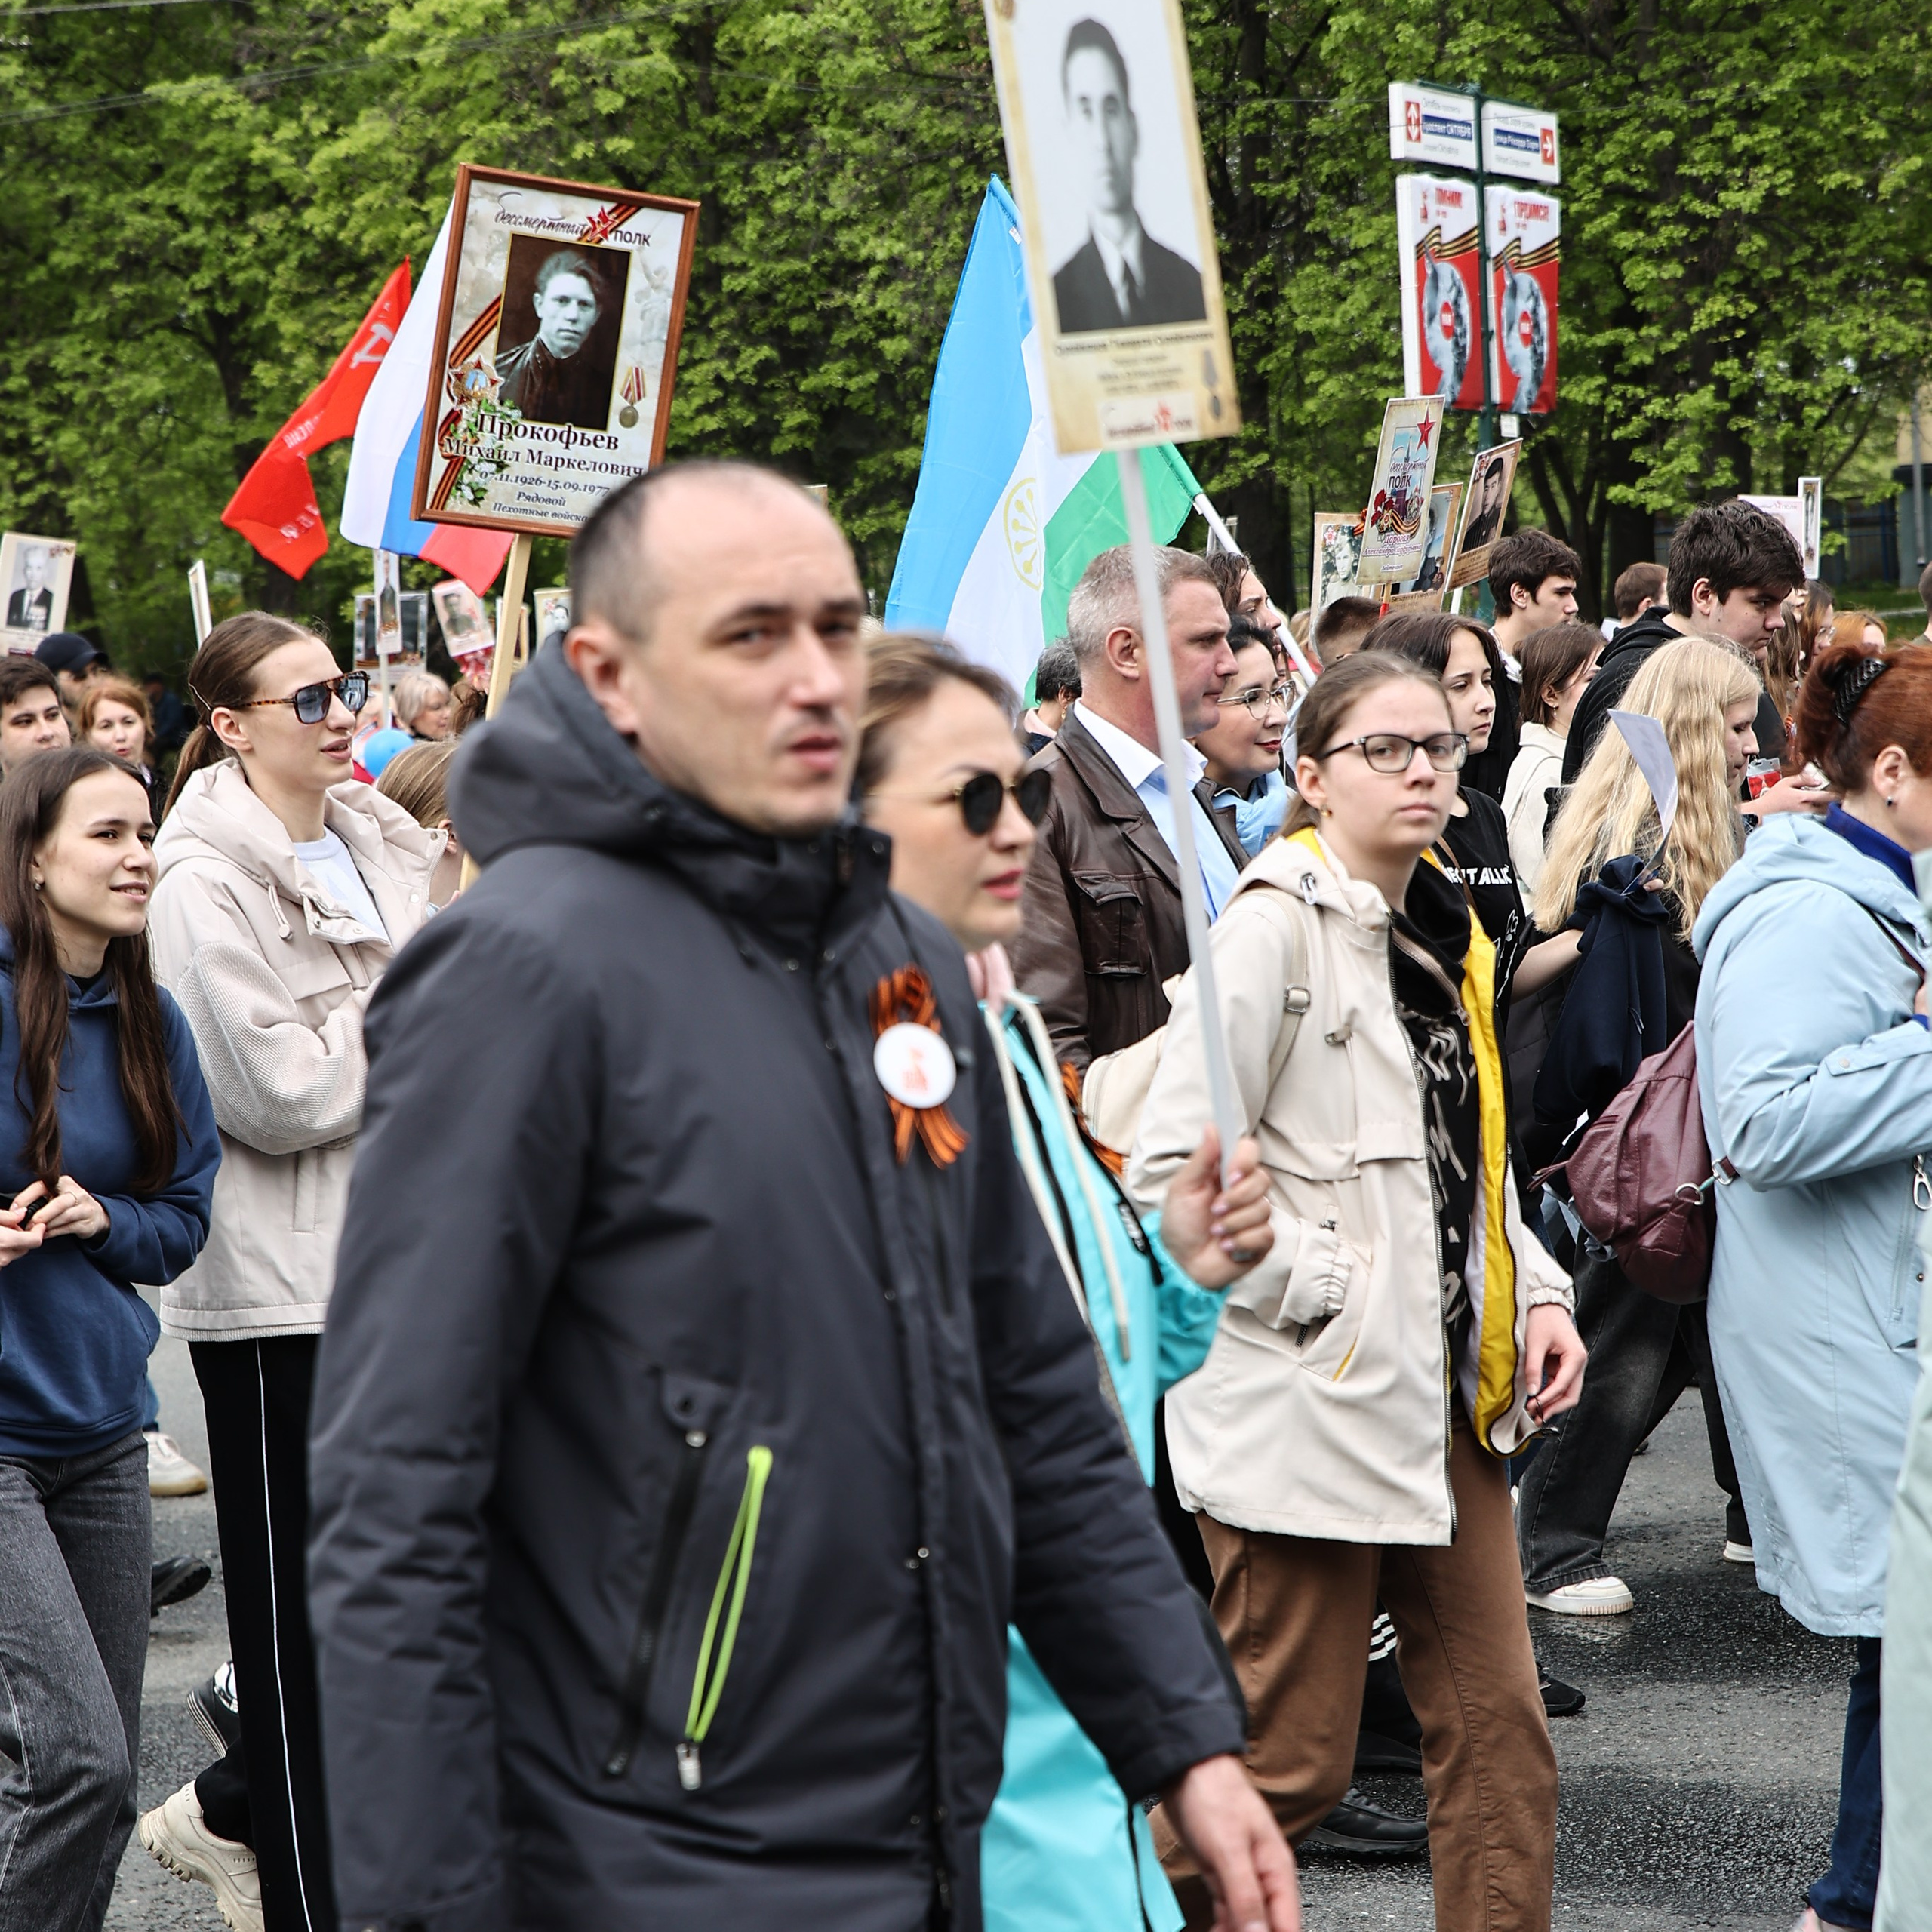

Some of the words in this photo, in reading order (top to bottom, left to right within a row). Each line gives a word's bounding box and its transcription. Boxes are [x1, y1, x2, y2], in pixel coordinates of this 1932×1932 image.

[477, 414, 619, 451] Прокофьев
[444, 438, 520, 462] Михаил
[526, 448, 644, 478] Маркелович
[1388, 475, 1412, 489] ПОЛК
[516, 491, 566, 507] Рядовой
[493, 503, 549, 519] Пехотные
[551, 511, 588, 523] войска
